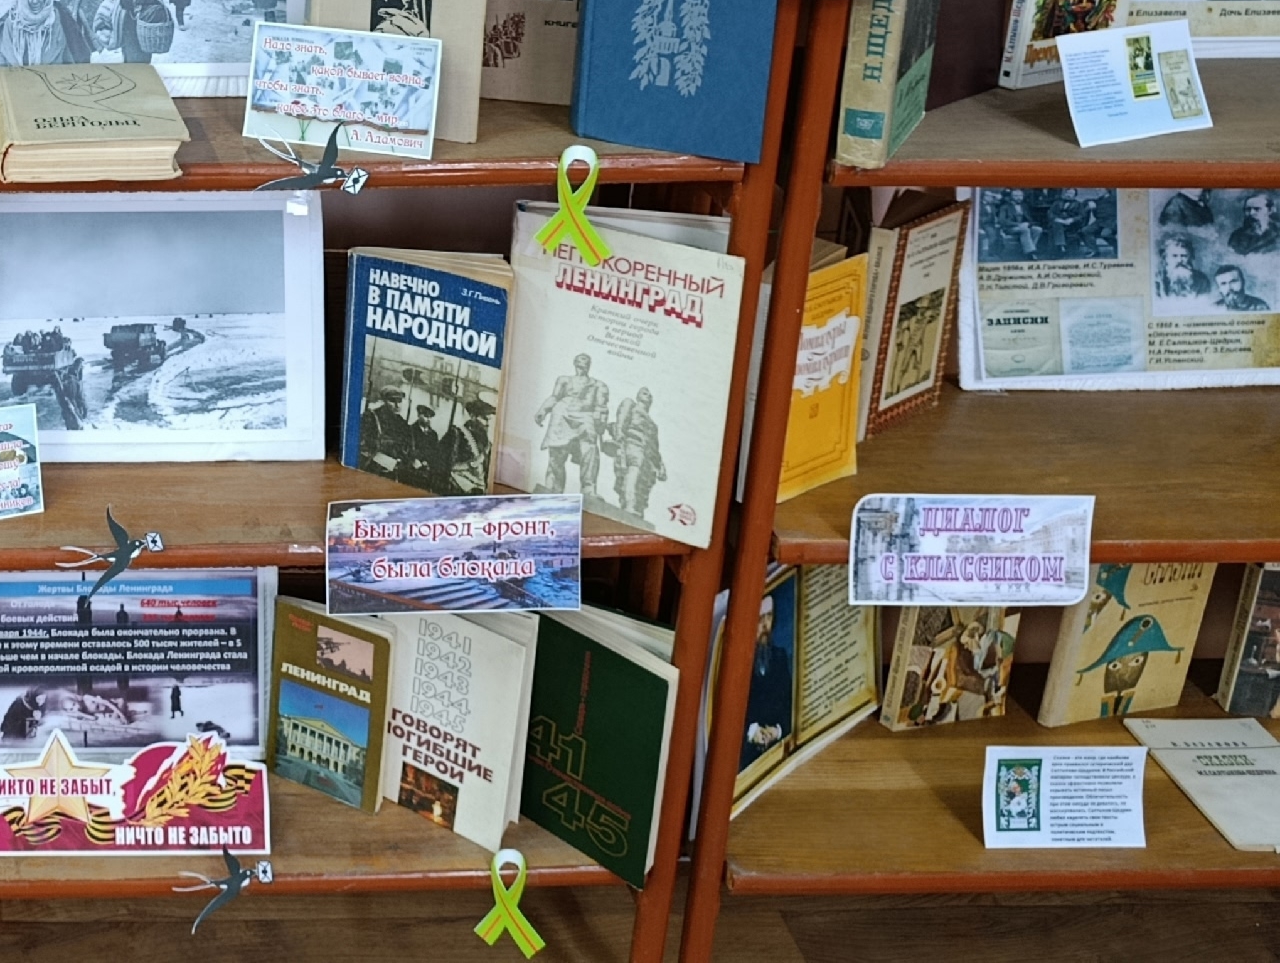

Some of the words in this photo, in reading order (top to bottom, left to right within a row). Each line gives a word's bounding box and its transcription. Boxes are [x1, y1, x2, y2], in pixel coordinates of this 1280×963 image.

[263, 37, 292, 51] Надо
[255, 79, 289, 92] чтобы
[311, 65, 344, 77] какой
[346, 67, 386, 81] бывает
[365, 130, 424, 149] Адамович
[369, 268, 441, 297] НАВЕЧНО
[555, 262, 704, 329] ЛЕНИНГРАД
[367, 286, 382, 307] В
[386, 289, 471, 327] ПАМЯТИ
[365, 306, 498, 360] НАРОДНОЙ
[353, 519, 401, 540] Был
[919, 507, 1031, 536] ДИАЛОГ
[372, 558, 433, 580] была
[436, 557, 535, 582] блокада
[880, 554, 895, 582] С
[904, 554, 1065, 583] КЛАССИКОМ
[0, 614, 35, 624] боевых
[419, 618, 472, 655] 1941
[11, 663, 88, 675] кровопролитной
[170, 662, 231, 672] человечества
[416, 638, 472, 677] 1942
[280, 661, 371, 704] ЛЕНИНГРАД
[414, 657, 470, 695] 1943
[411, 676, 471, 716] 1944
[409, 696, 466, 734] 1945
[391, 707, 481, 758] ГОВОРЯТ
[529, 715, 587, 780] 41
[401, 743, 464, 784] ГЕРОИ
[39, 779, 57, 795] НЕ
[60, 778, 116, 797] ЗАБЫТ,
[115, 827, 164, 846] НИЧТО
[167, 827, 186, 845] НЕ
[189, 825, 252, 845] ЗАБЫТО
[542, 782, 629, 857] 45
